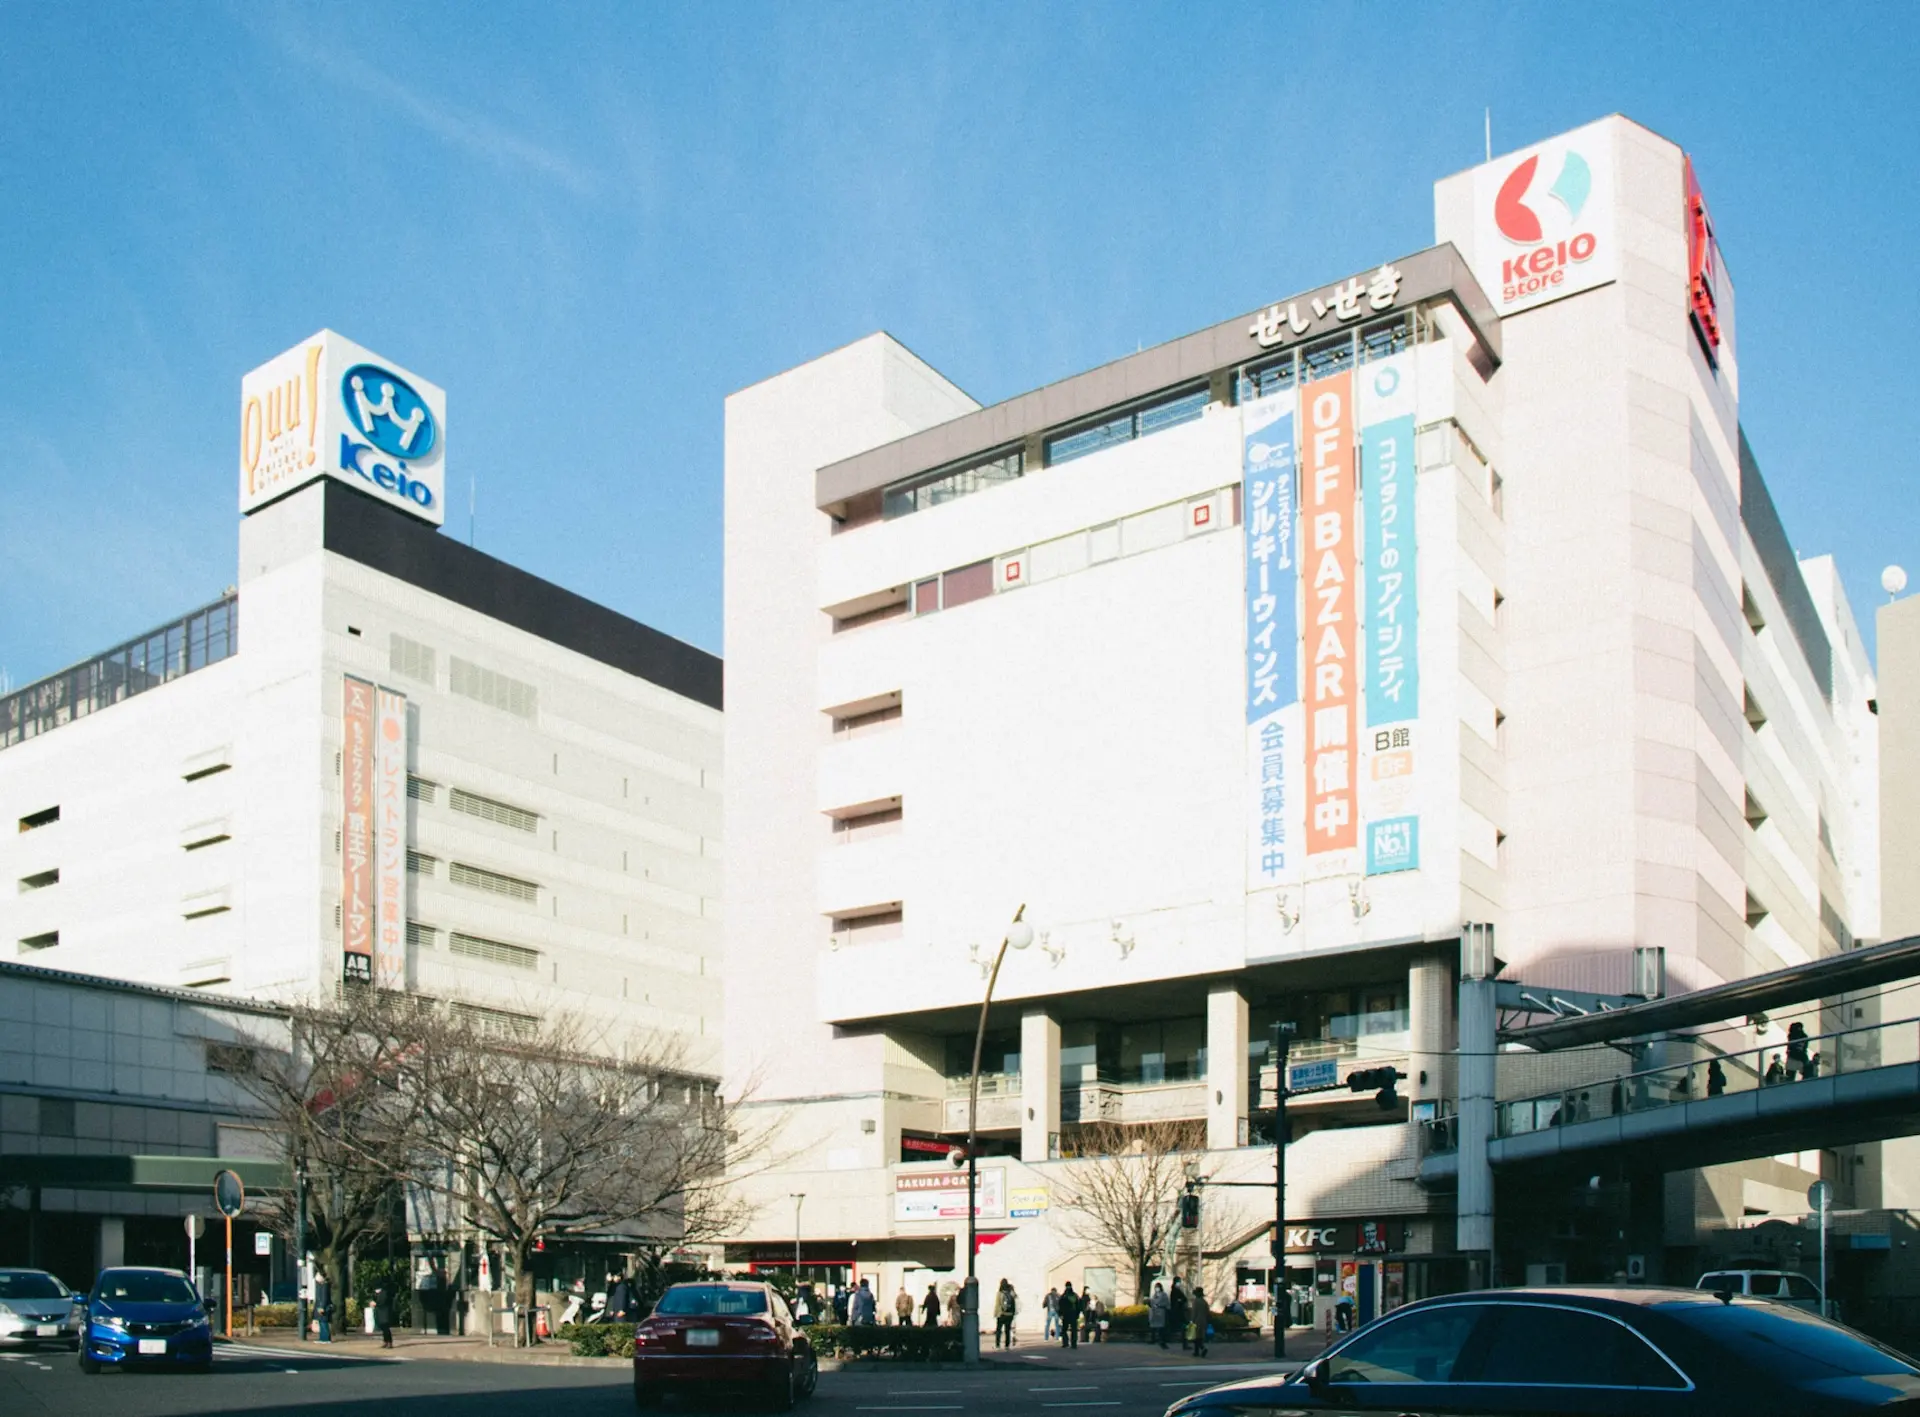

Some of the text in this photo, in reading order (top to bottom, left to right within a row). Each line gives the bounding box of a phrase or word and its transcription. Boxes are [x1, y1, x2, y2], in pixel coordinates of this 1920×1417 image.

[1249, 263, 1403, 349] せいせき
[341, 433, 433, 506] Keio
[1313, 392, 1340, 506] OFF
[1314, 511, 1347, 701] BAZAR
[1377, 437, 1404, 703] コンタクトのアイシティ
[1374, 728, 1410, 752] B館
[1260, 721, 1286, 878] 会員募集中
[897, 1176, 941, 1189] SAKURA
[1285, 1228, 1338, 1248] KFC
